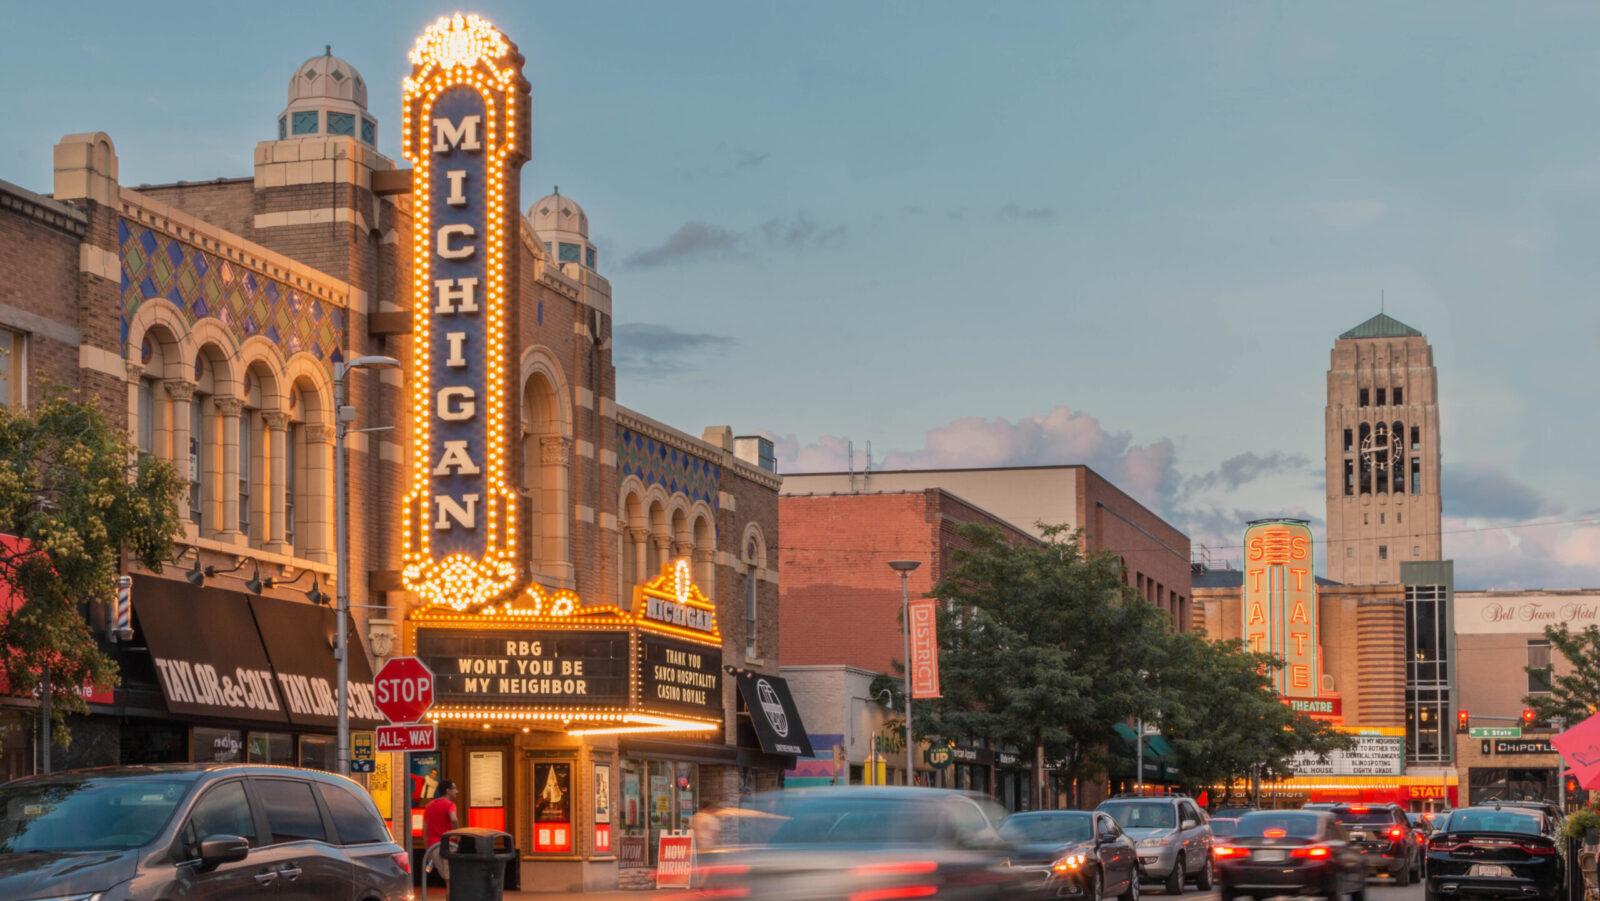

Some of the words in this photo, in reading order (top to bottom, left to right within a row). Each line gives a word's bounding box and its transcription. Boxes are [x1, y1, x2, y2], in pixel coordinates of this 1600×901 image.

[432, 115, 481, 530] MICHIGAN
[646, 596, 713, 632] MICHIGAN
[1290, 536, 1308, 689] STATE
[1481, 602, 1515, 622] Bell
[1518, 602, 1555, 622] Tower
[1560, 602, 1598, 622] Hotel
[506, 640, 542, 656] RBG
[916, 609, 932, 690] DISTRICT
[458, 659, 508, 675] WONT
[517, 660, 553, 676] YOU
[562, 660, 583, 676] BE
[665, 648, 686, 666] THANK
[688, 654, 701, 669] YOU
[465, 678, 490, 693] MY
[499, 678, 587, 694] NEIGHBOR
[654, 665, 675, 682] SAVCO
[677, 670, 716, 689] HOSPITALITY
[377, 678, 430, 704] STOP
[657, 684, 680, 701] CASINO
[682, 688, 706, 705] ROYALE
[1290, 700, 1333, 713] THEATRE
[379, 731, 401, 747] ALL
[409, 730, 432, 745] WAY
[930, 752, 949, 764] UP
[664, 844, 688, 860] NOW
[659, 861, 691, 876] HIRING
